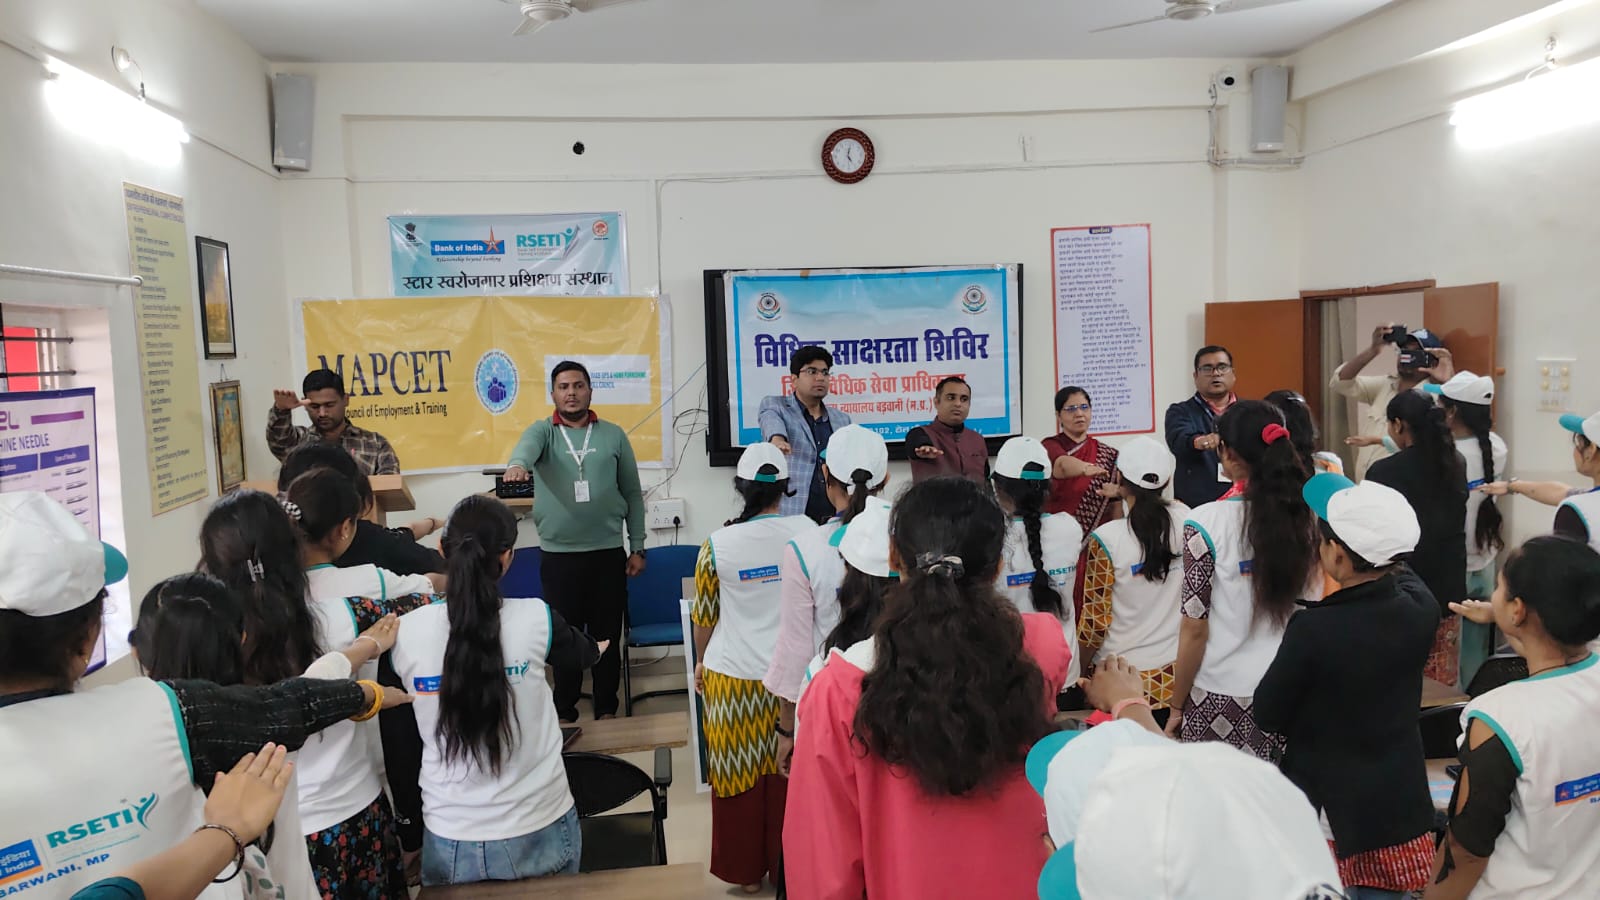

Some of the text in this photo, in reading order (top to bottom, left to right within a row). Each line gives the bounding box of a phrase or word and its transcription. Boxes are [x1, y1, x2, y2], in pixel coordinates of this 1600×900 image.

[434, 243, 484, 252] Bank of India
[516, 234, 560, 247] RSETI
[403, 268, 613, 289] स्टार स्वरोजगार प्रशिक्षण संस्थान
[754, 327, 989, 367] विधि साक्षरता शिविर
[317, 350, 452, 397] MAPCET
[870, 372, 897, 394] सेवा
[345, 401, 447, 420] ouncil of Employment & Training
[19, 432, 50, 449] NEEDLE
[46, 809, 134, 848] RSETI
[5, 859, 35, 873] India
[86, 853, 110, 867] MP
